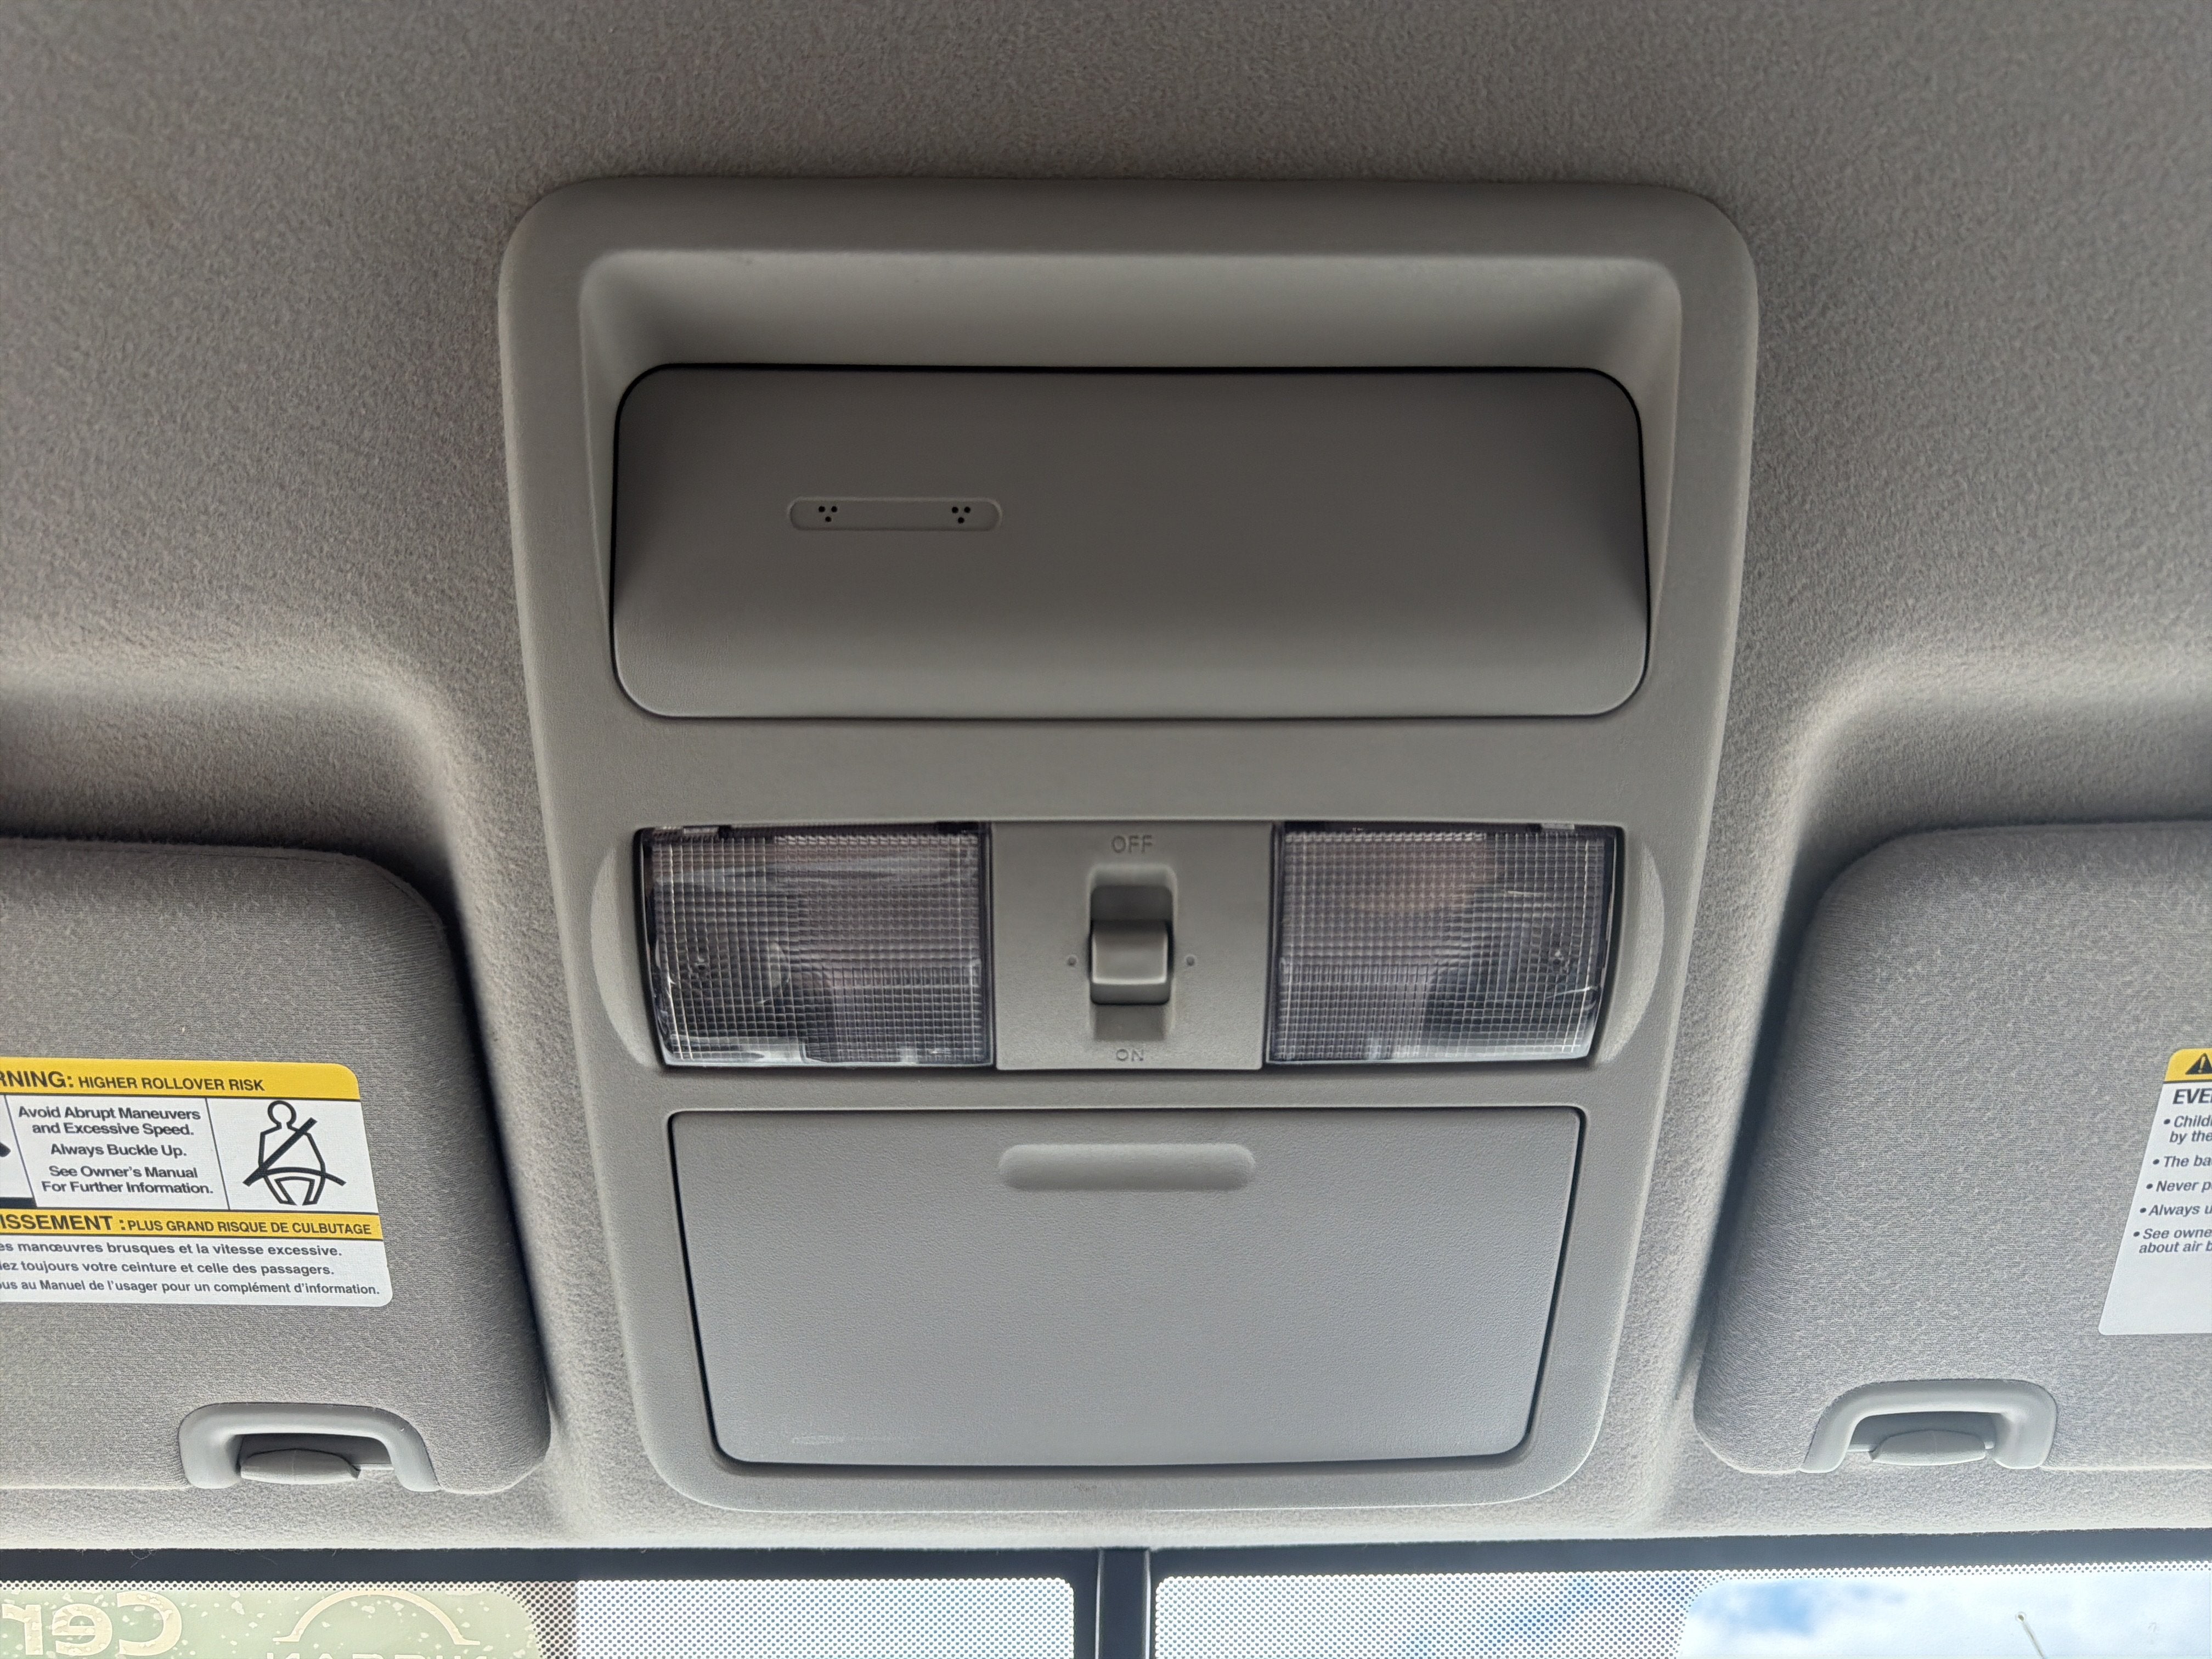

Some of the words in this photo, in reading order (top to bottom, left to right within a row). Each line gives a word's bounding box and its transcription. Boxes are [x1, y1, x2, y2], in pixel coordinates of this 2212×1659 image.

[1111, 834, 1153, 854] OFF
[1115, 1048, 1144, 1063] ON
[78, 1076, 138, 1088] HIGHER
[142, 1077, 225, 1090] ROLLOVER
[229, 1079, 265, 1091] RISK
[2172, 1088, 2212, 1104] EVE
[19, 1106, 61, 1118] Avoid
[65, 1107, 116, 1121] Abrupt
[118, 1108, 201, 1120] Maneuvers
[2174, 1115, 2212, 1128] Child
[32, 1122, 61, 1133] and
[63, 1122, 139, 1134] Excessive
[143, 1123, 194, 1137] Speed.
[2169, 1131, 2187, 1145] by
[2191, 1130, 2212, 1142] the
[51, 1144, 104, 1158] Always
[107, 1144, 158, 1155] Buckle
[161, 1145, 187, 1159] Up.
[2164, 1156, 2189, 1167] The
[2193, 1155, 2212, 1167] ba
[49, 1166, 77, 1176] See
[81, 1166, 142, 1177] Owner’s
[144, 1167, 198, 1178] Manual
[42, 1181, 66, 1192] For
[70, 1181, 123, 1192] Further
[126, 1182, 213, 1193] Information.
[2155, 1180, 2199, 1192] Never
[2201, 1181, 2212, 1193] p
[2148, 1204, 2200, 1217] Always
[127, 1220, 163, 1231] PLUS
[166, 1221, 214, 1232] GRAND
[217, 1221, 268, 1232] RISQUE
[270, 1222, 289, 1232] DE
[292, 1223, 371, 1234] CULBUTAGE
[2143, 1228, 2169, 1239] See
[18, 1244, 103, 1252] manœuvres
[106, 1243, 175, 1255] brusques
[179, 1244, 193, 1254] et
[196, 1244, 209, 1254] la
[212, 1244, 263, 1254] vitesse
[268, 1245, 342, 1256] excessive.
[2139, 1242, 2179, 1254] about
[2182, 1240, 2203, 1252] air
[21, 1261, 79, 1273] toujours
[82, 1262, 117, 1271] votre
[122, 1262, 177, 1272] ceinture
[180, 1263, 194, 1272] et
[198, 1263, 228, 1273] celle
[233, 1263, 257, 1273] des
[261, 1266, 334, 1277] passagers.
[0, 1281, 18, 1290] us
[40, 1280, 86, 1290] Manuel
[89, 1280, 104, 1290] de
[107, 1280, 157, 1293] l’usager
[162, 1284, 190, 1294] pour
[214, 1282, 291, 1295] complément
[294, 1283, 379, 1294] d’information.
